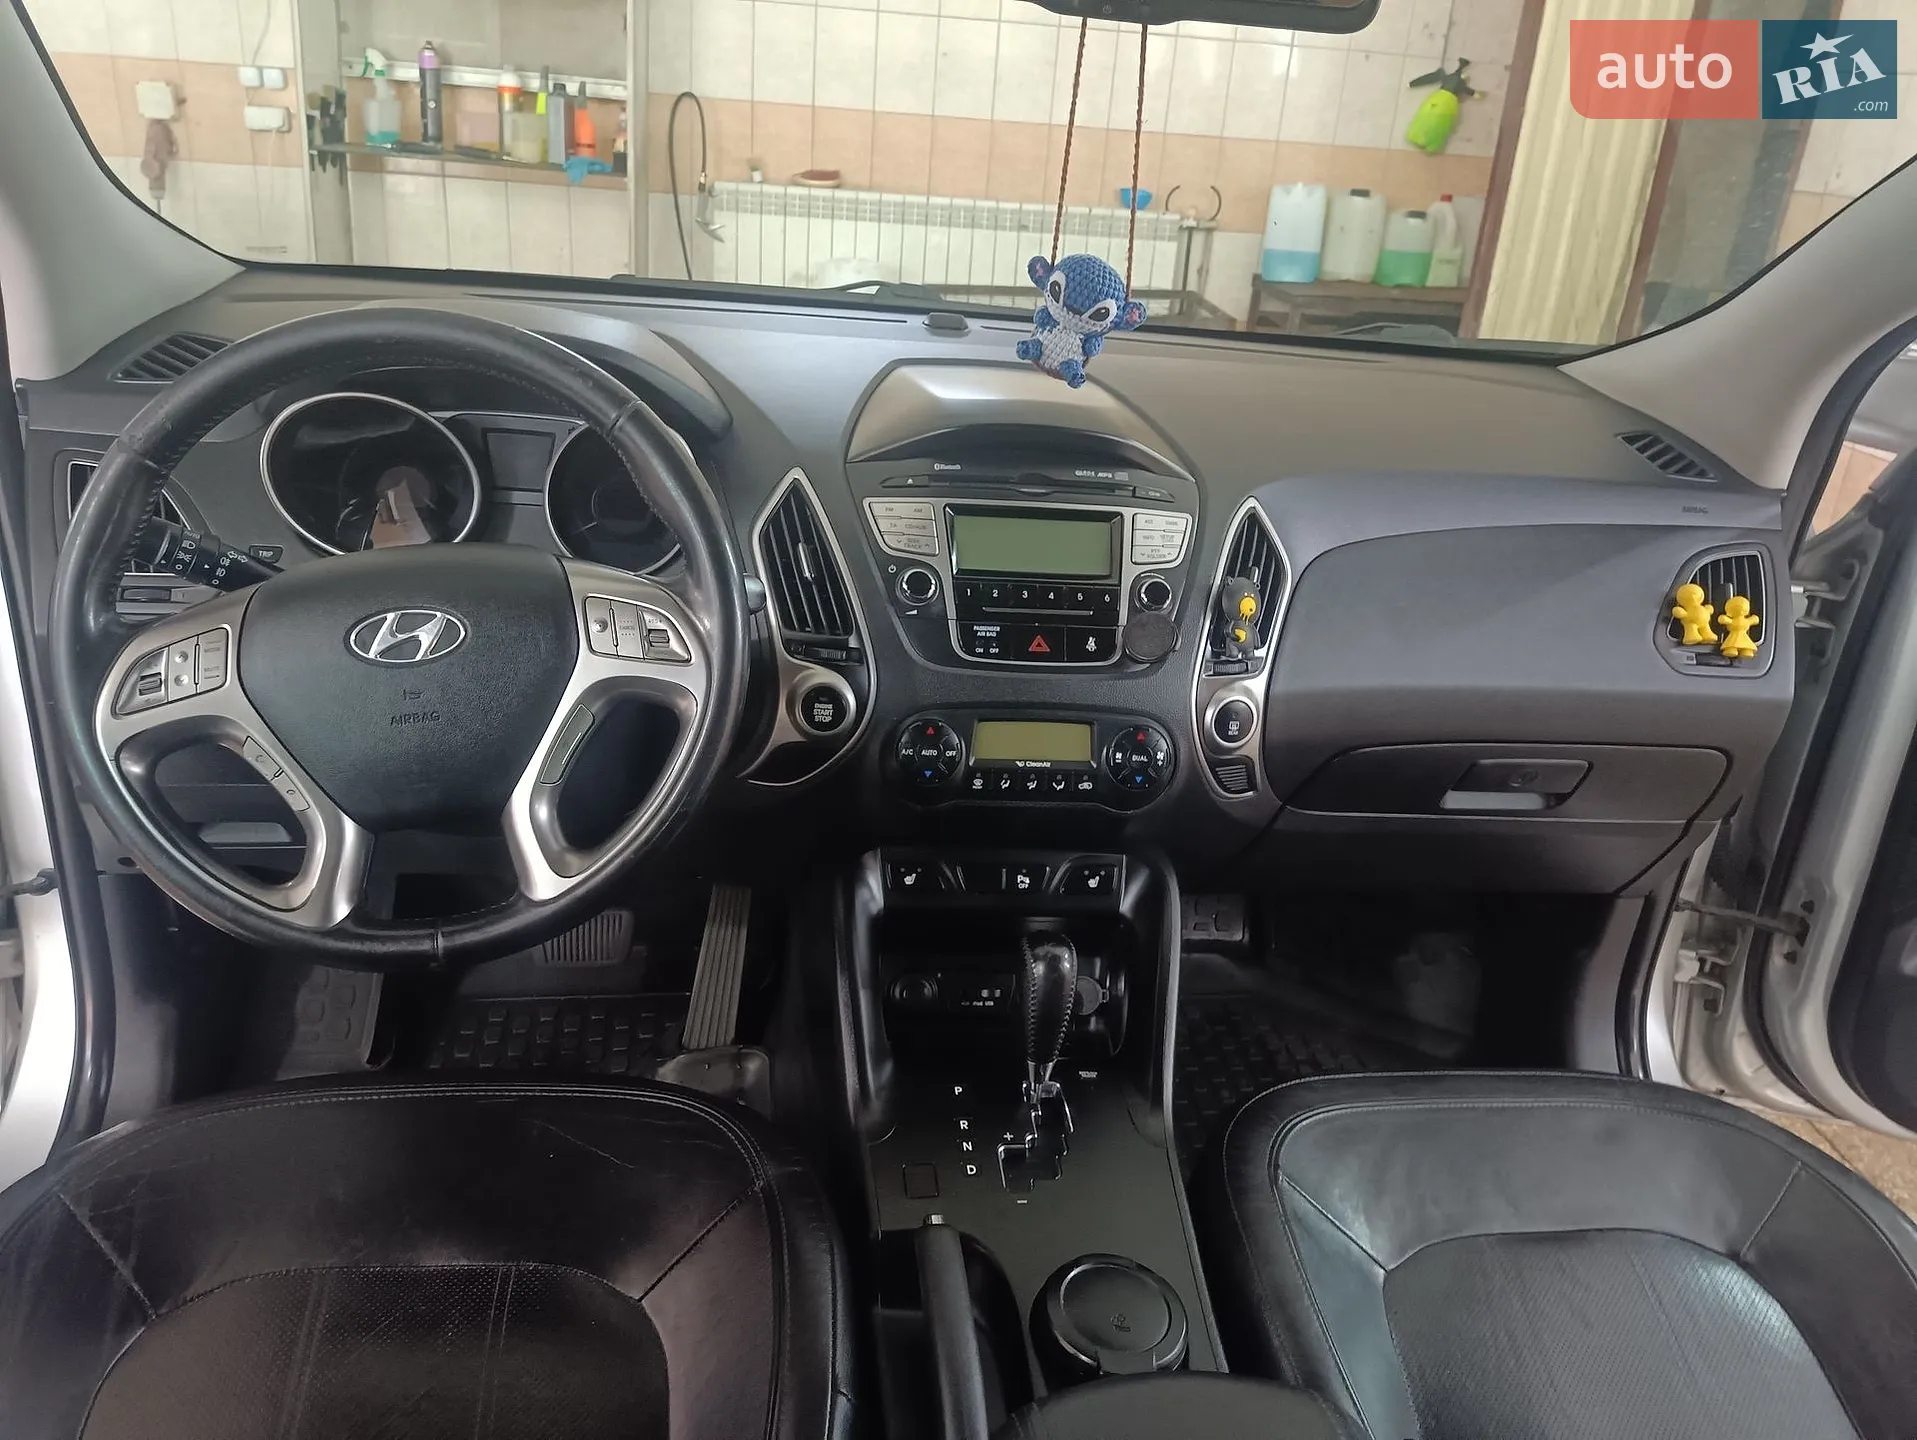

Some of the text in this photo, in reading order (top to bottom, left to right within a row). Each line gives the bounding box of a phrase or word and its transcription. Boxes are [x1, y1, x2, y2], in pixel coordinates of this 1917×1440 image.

[258, 550, 274, 559] TRIP
[966, 588, 1110, 602] 1 2 3 4 5 6
[390, 710, 441, 727] AIRBAG
[901, 748, 914, 756] A/C
[1131, 754, 1148, 762] DUAL
[954, 1086, 963, 1095] P
[960, 1120, 969, 1130] R
[963, 1141, 973, 1151] N
[966, 1164, 976, 1175] D
